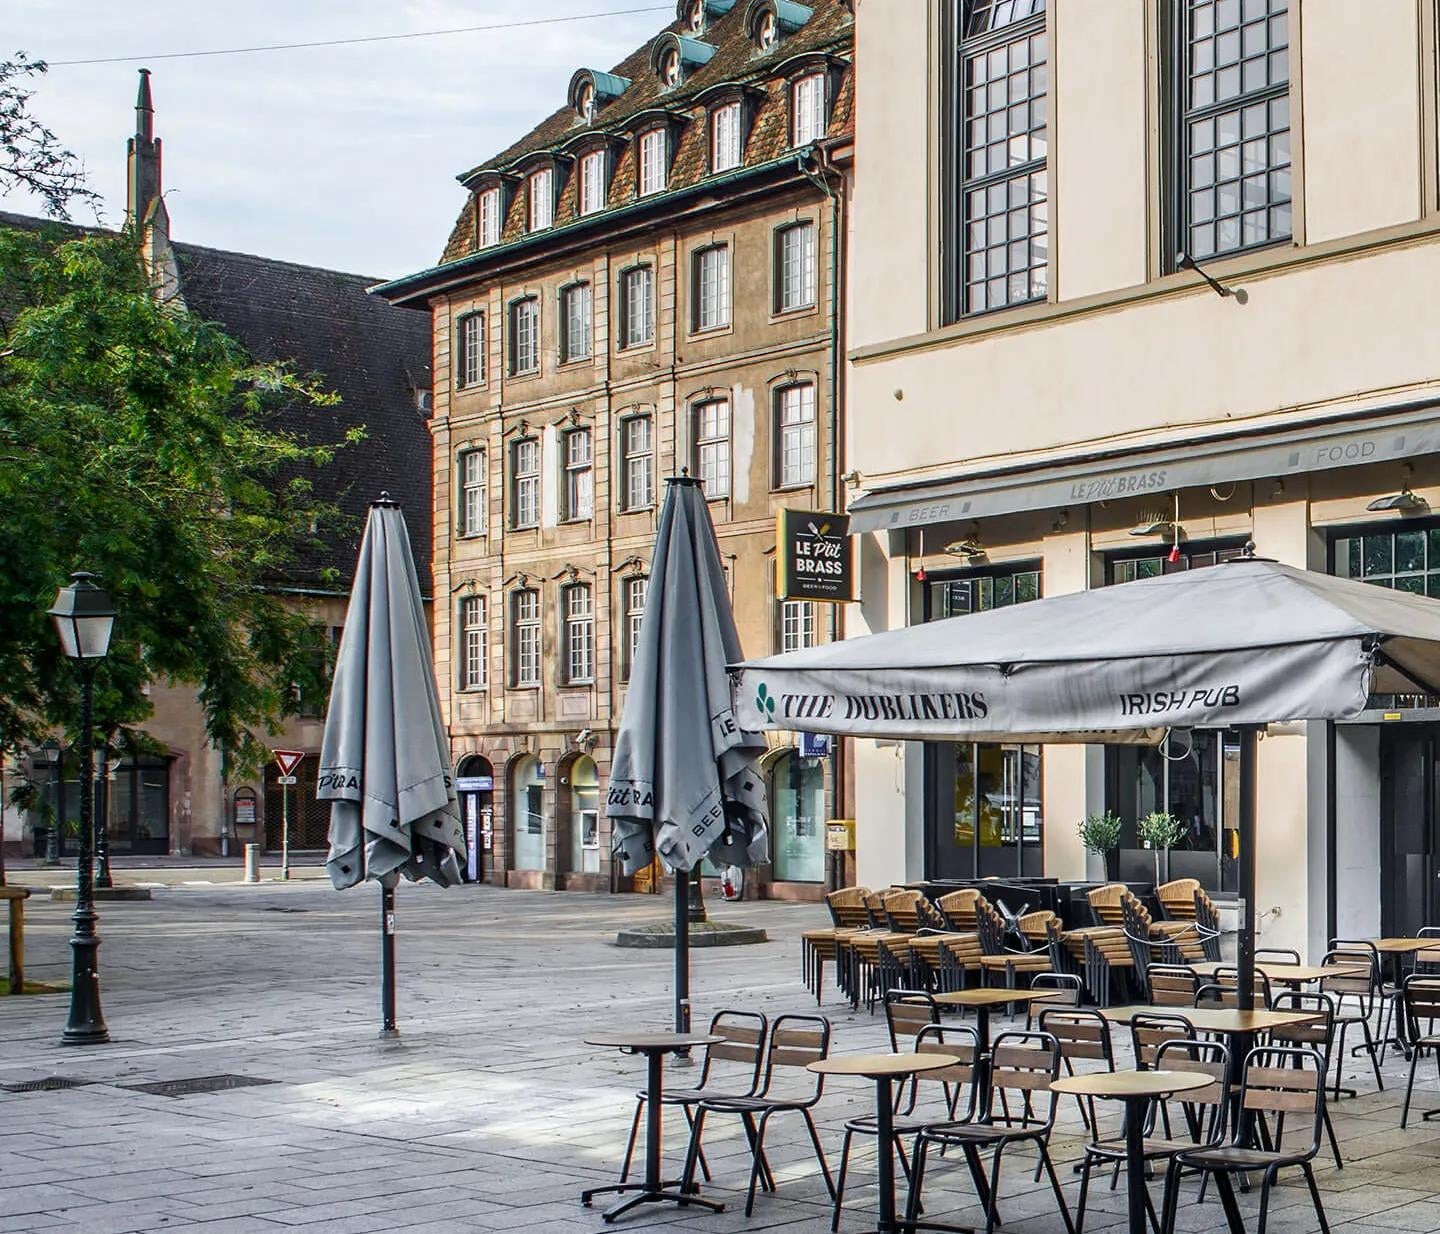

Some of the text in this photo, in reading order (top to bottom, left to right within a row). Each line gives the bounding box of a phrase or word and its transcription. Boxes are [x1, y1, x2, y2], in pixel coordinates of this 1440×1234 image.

[1317, 441, 1376, 463] FOOD
[1071, 480, 1085, 498] LE
[1117, 470, 1168, 492] BRASS
[909, 504, 950, 522] BEER
[796, 541, 811, 555] LE
[796, 558, 842, 574] BRASS
[781, 691, 990, 721] THE DUBLINERS
[1120, 685, 1241, 715] IRISH PUB
[719, 718, 737, 739] LE
[692, 801, 724, 838] BEE
